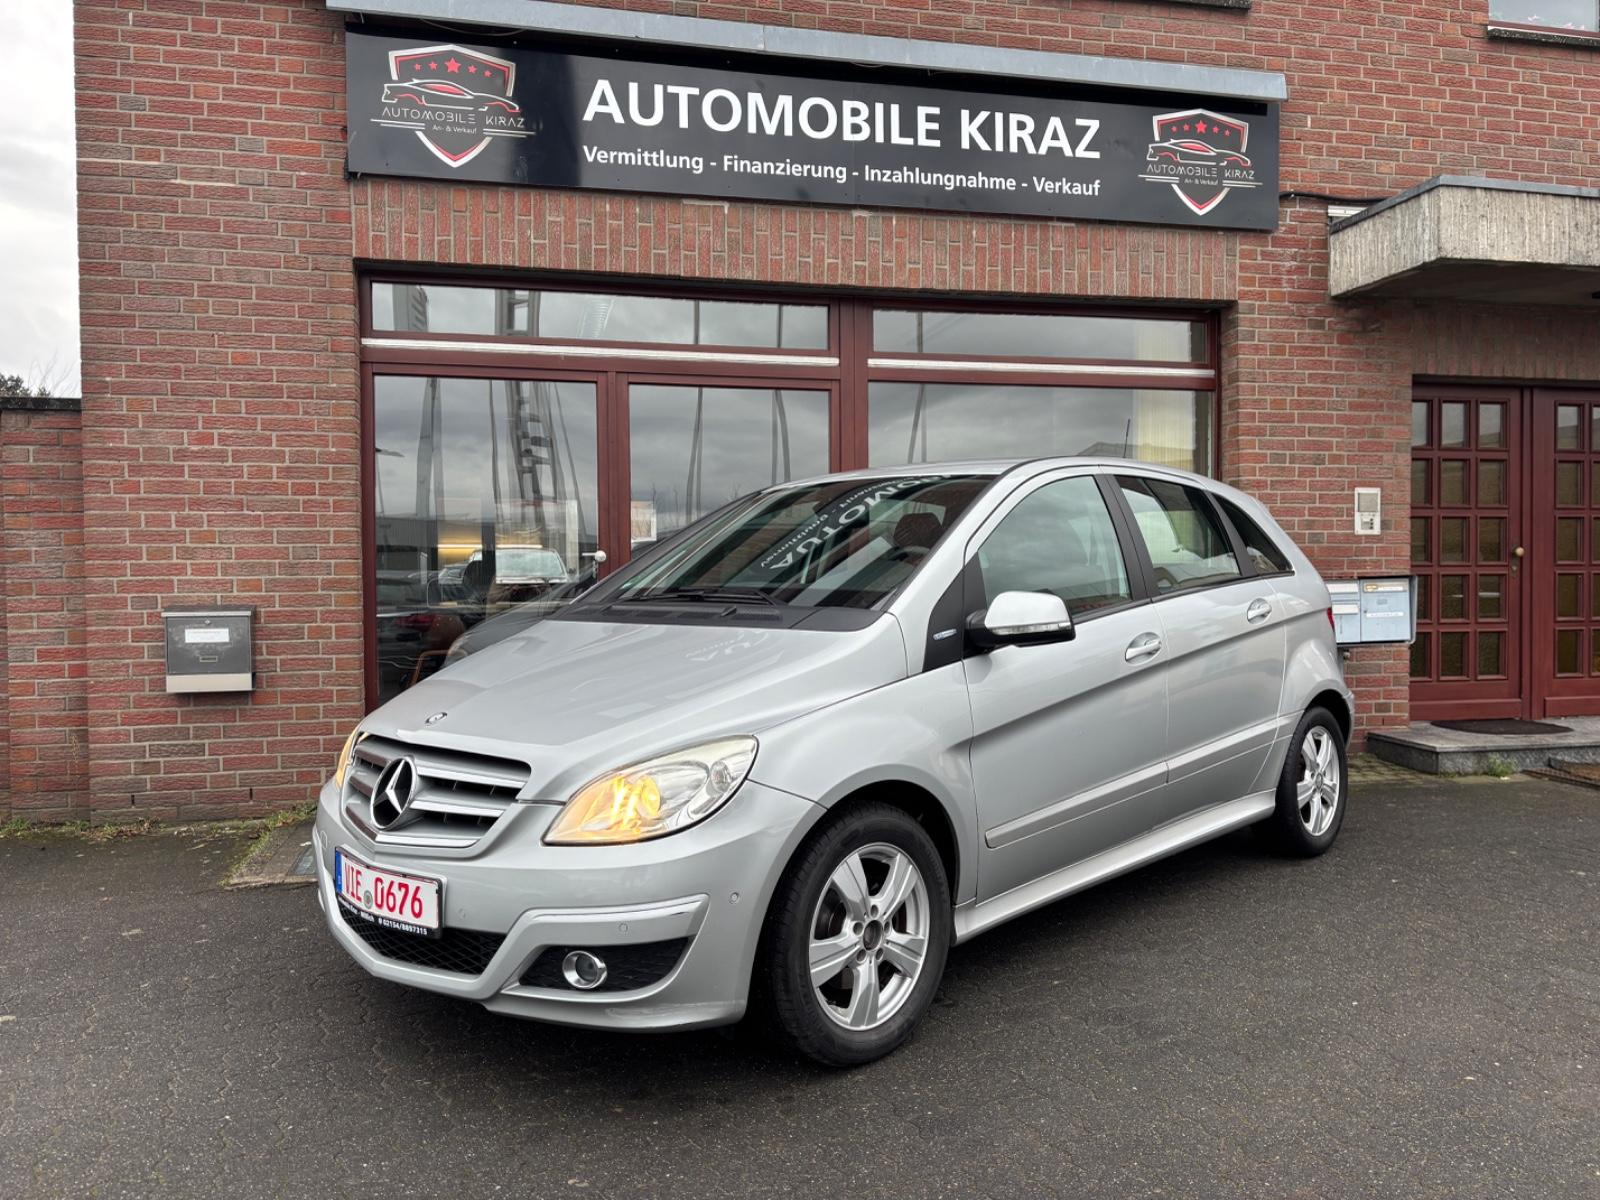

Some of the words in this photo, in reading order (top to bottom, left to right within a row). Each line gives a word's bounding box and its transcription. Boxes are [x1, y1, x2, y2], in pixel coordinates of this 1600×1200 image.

[381, 106, 477, 124] AUTOMOBILE
[485, 115, 525, 129] KIRAZ
[583, 79, 941, 147] AUTOMOBILE
[960, 109, 1102, 160] KIRAZ
[582, 144, 704, 175] Vermittlung
[723, 154, 847, 184] Finanzierung
[864, 164, 1017, 191] Inzahlungnahme
[1032, 175, 1101, 197] Verkauf
[1146, 163, 1218, 177] AUTOMOBILE
[1224, 168, 1255, 180] KIRAZ
[344, 862, 362, 902] VIE
[373, 876, 424, 919] 0676
